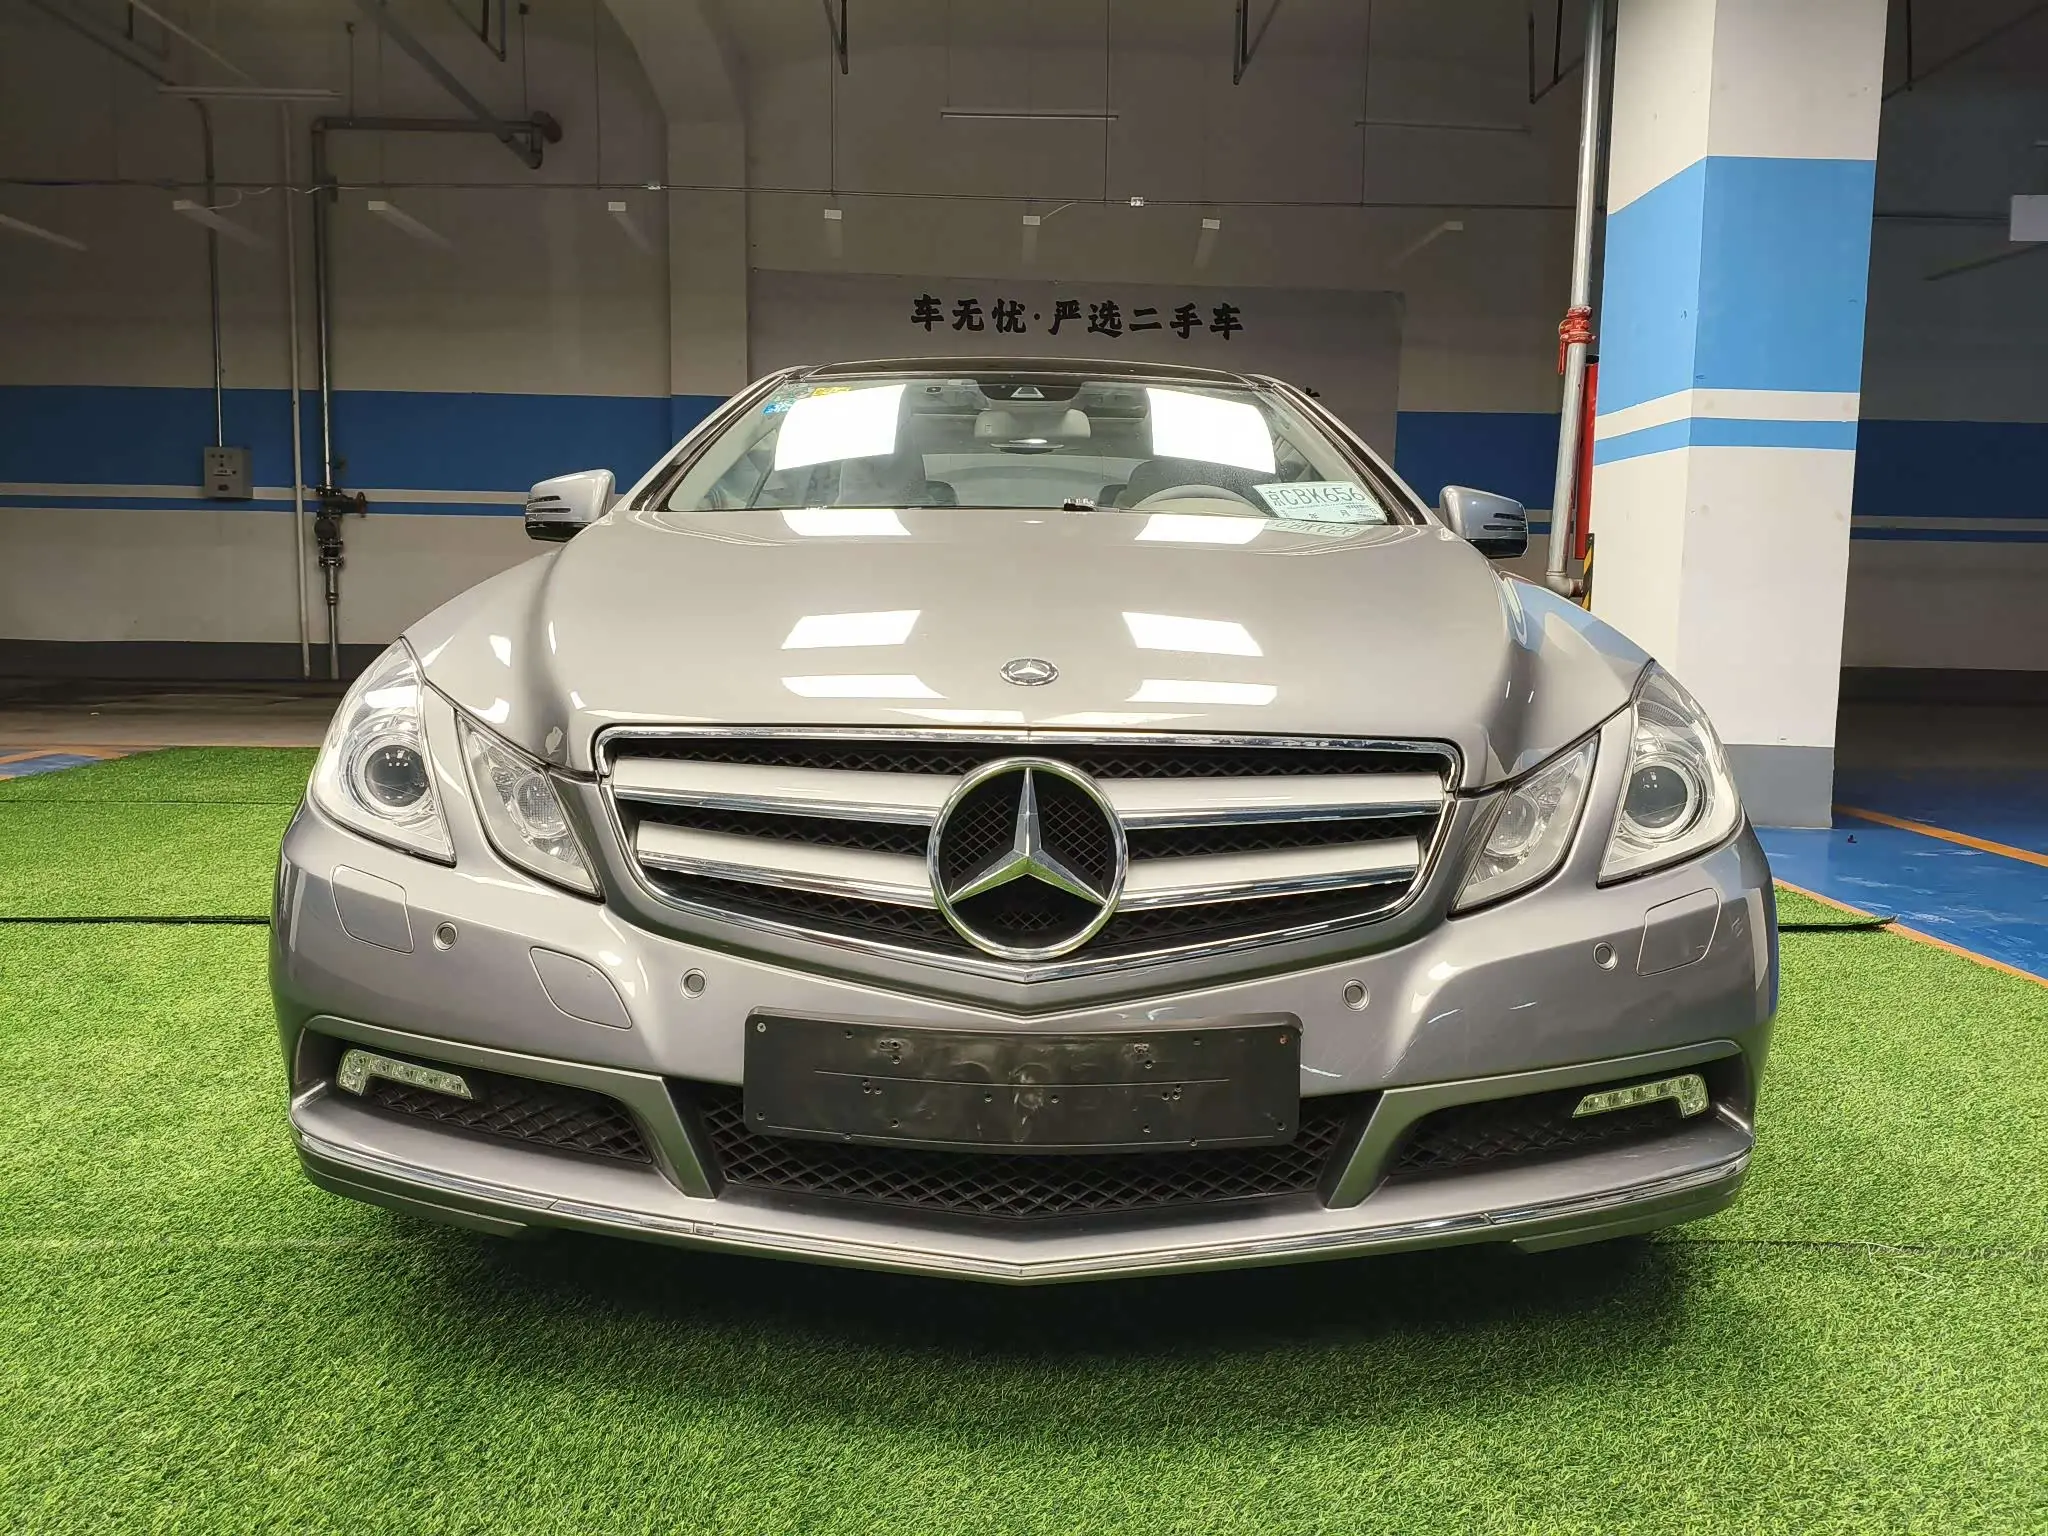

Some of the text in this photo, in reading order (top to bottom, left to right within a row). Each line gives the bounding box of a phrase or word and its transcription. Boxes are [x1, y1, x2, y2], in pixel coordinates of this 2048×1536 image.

[911, 294, 1243, 340] 车无忧·严选二手车
[1265, 487, 1366, 507] 京CBK656
